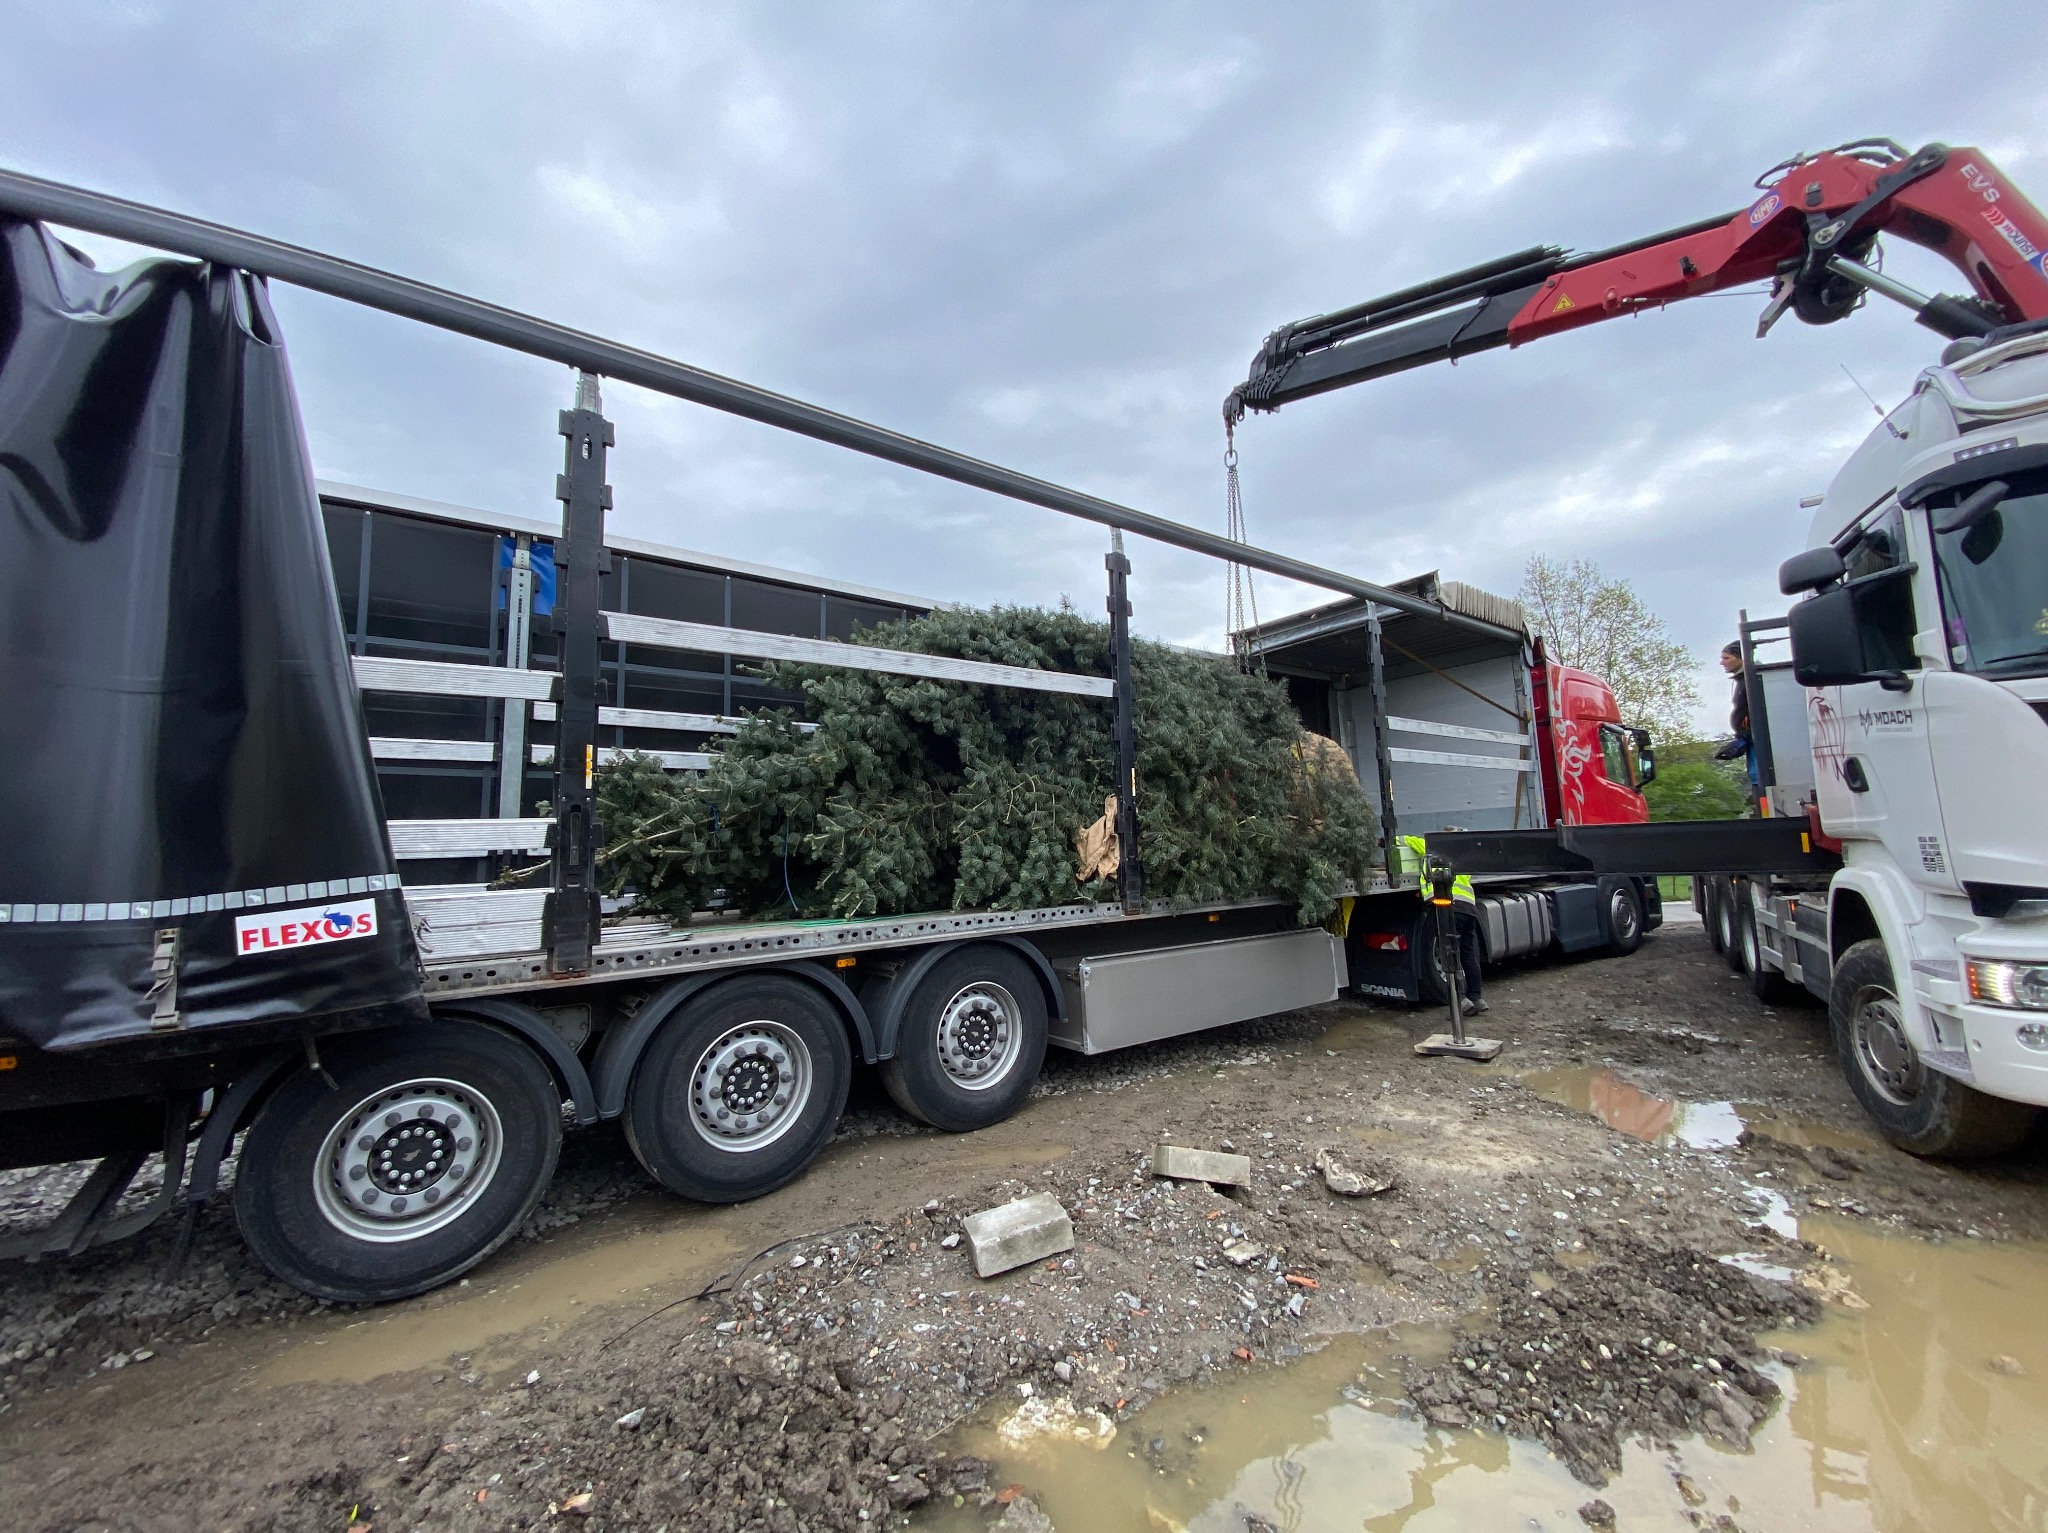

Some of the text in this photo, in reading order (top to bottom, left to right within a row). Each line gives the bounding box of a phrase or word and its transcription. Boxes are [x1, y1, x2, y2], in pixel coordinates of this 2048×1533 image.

[1960, 163, 2000, 203] EVS
[1753, 198, 1776, 221] HMF
[242, 912, 373, 951] FLEXOS
[1361, 983, 1407, 998] SCANIA
